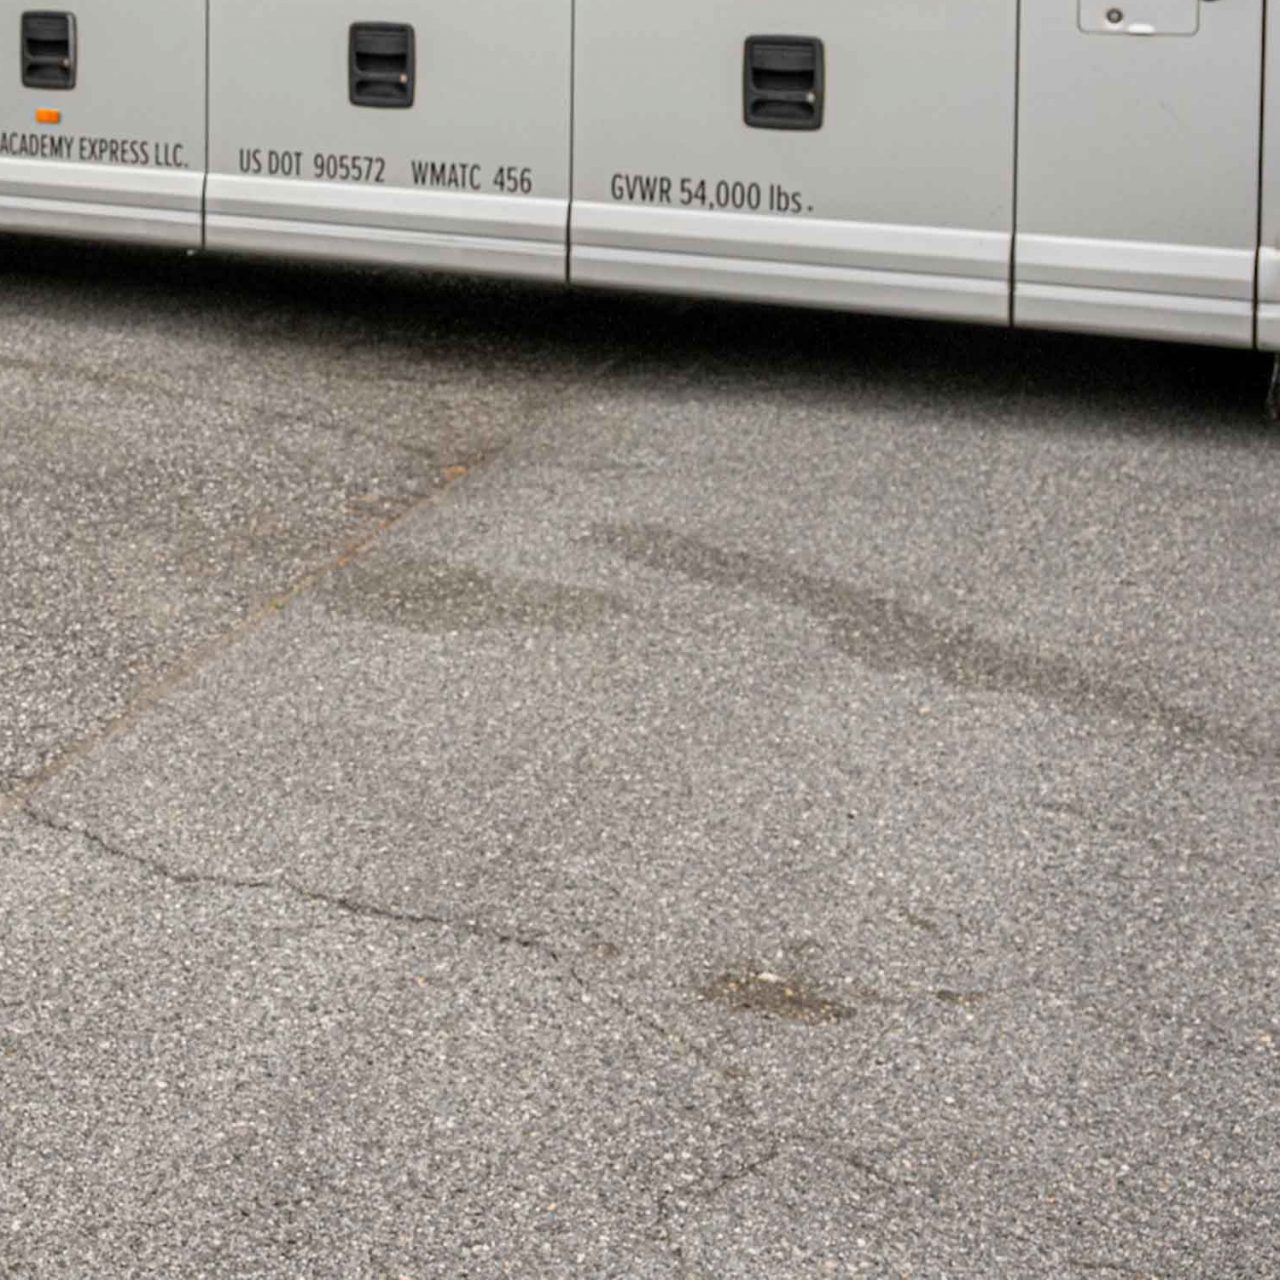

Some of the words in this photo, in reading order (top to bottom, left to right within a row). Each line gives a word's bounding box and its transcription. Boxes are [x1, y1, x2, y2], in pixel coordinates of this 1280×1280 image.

[0, 131, 74, 159] ACADEMY
[79, 136, 150, 165] EXPRESS
[154, 141, 189, 168] LLC.
[239, 148, 262, 174] US
[268, 150, 303, 176] DOT
[313, 152, 386, 183] 905572
[410, 160, 481, 191] WMATC
[493, 165, 532, 194] 456
[611, 173, 672, 204] GVWR
[679, 177, 761, 211] 54,000
[768, 183, 814, 214] lbs.
